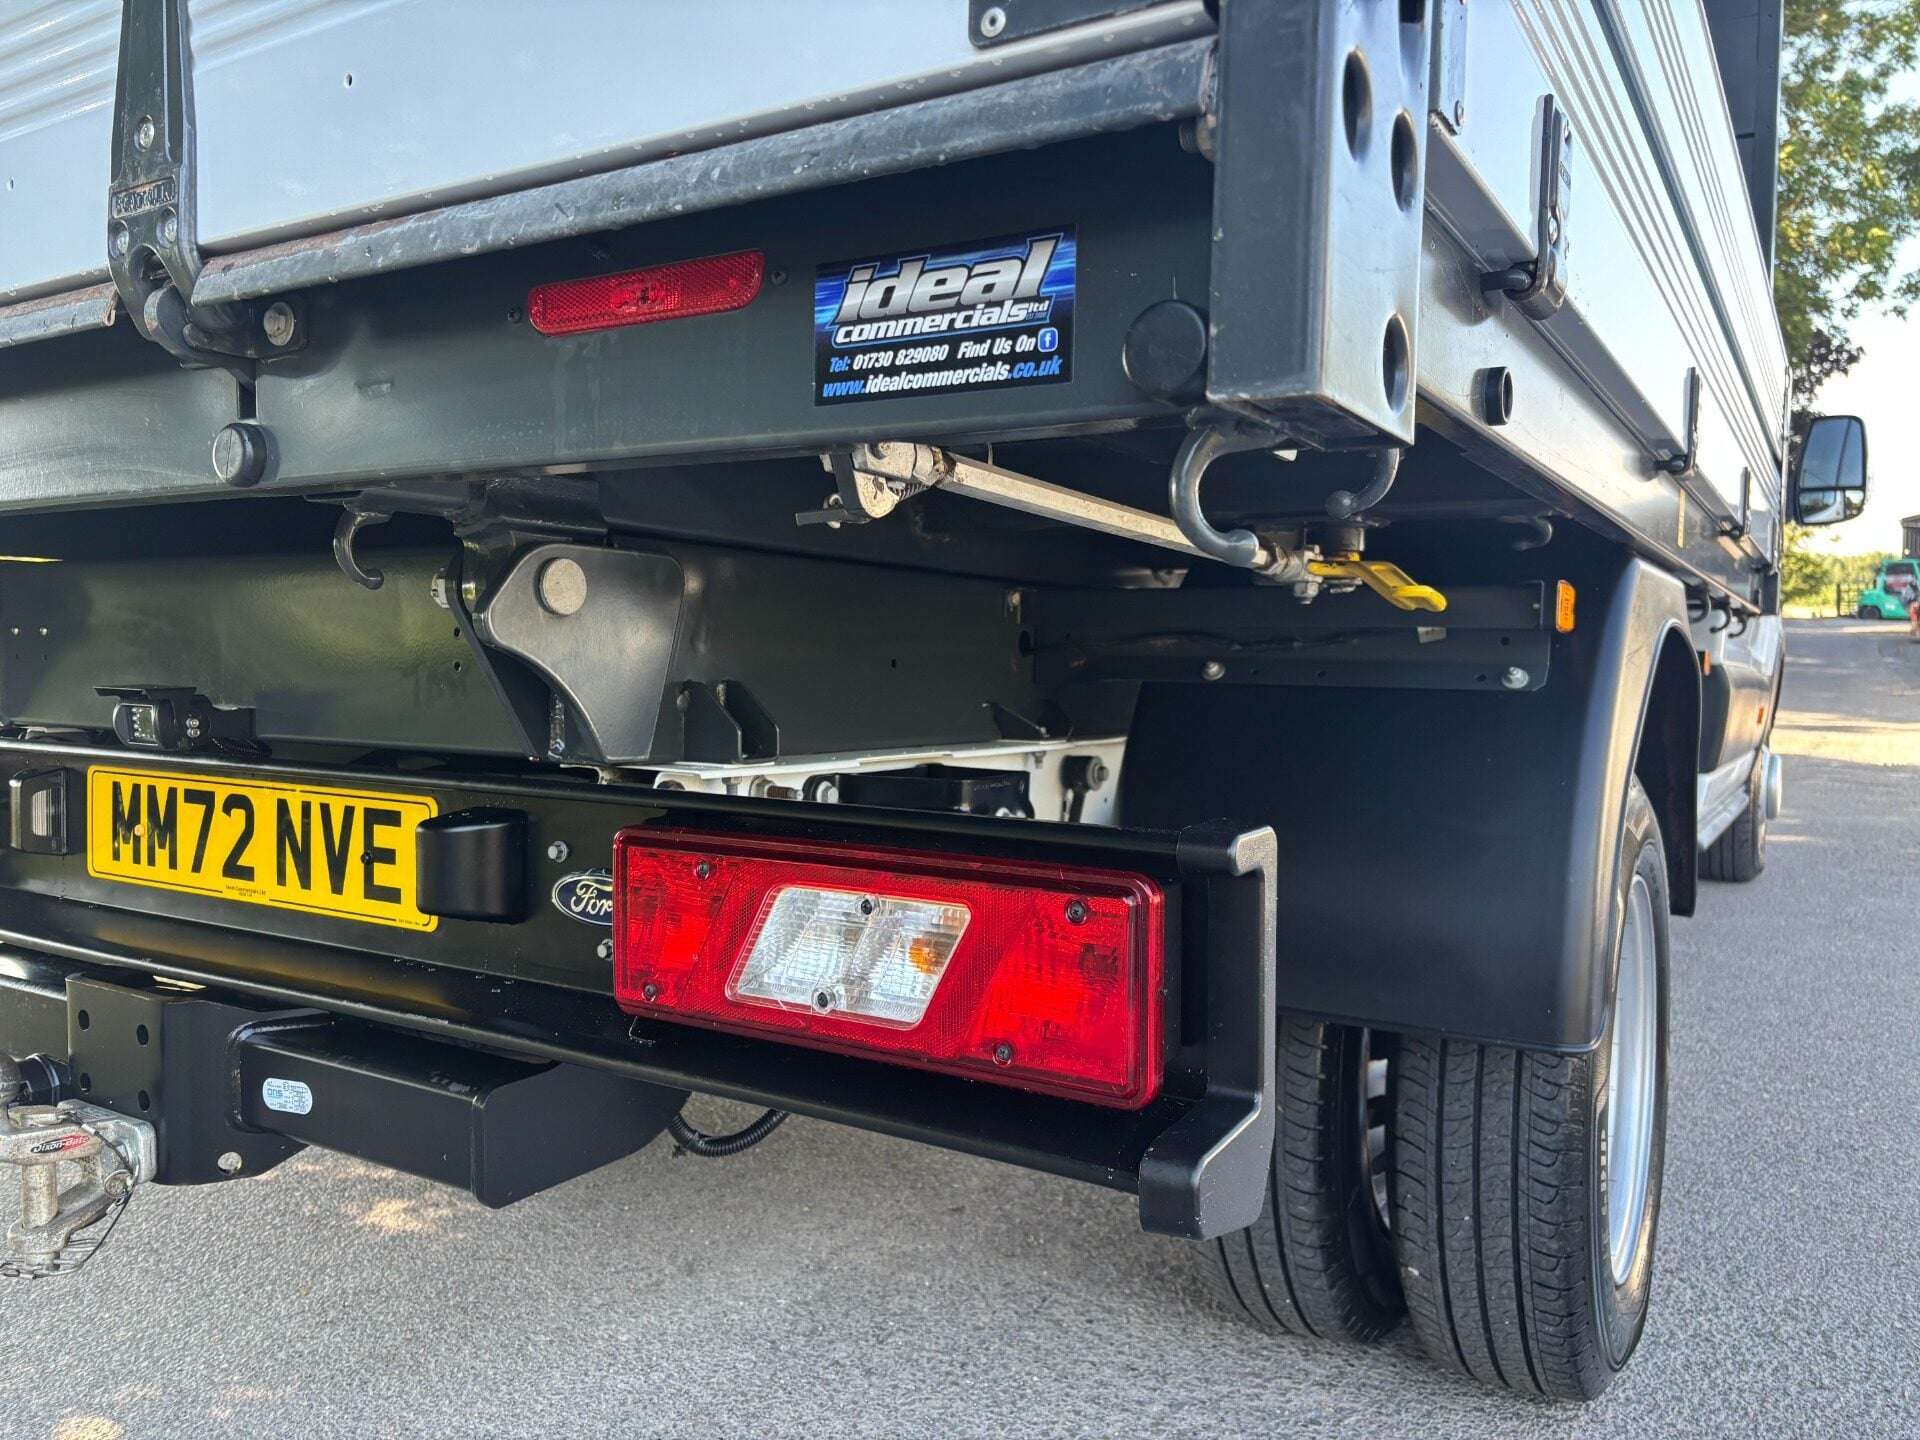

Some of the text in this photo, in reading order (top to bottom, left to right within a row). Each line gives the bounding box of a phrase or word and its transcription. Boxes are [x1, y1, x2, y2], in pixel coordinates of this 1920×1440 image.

[836, 238, 1059, 323] ideal
[836, 300, 1028, 344] commercials
[830, 356, 849, 373] Tel:
[852, 351, 894, 370] 01730
[957, 339, 989, 359] Find
[992, 337, 1012, 354] Us
[1015, 334, 1036, 352] On
[822, 355, 1063, 398] www.idealcommercials.co.uk
[112, 780, 402, 905] MM72 NVE
[571, 881, 613, 915] For
